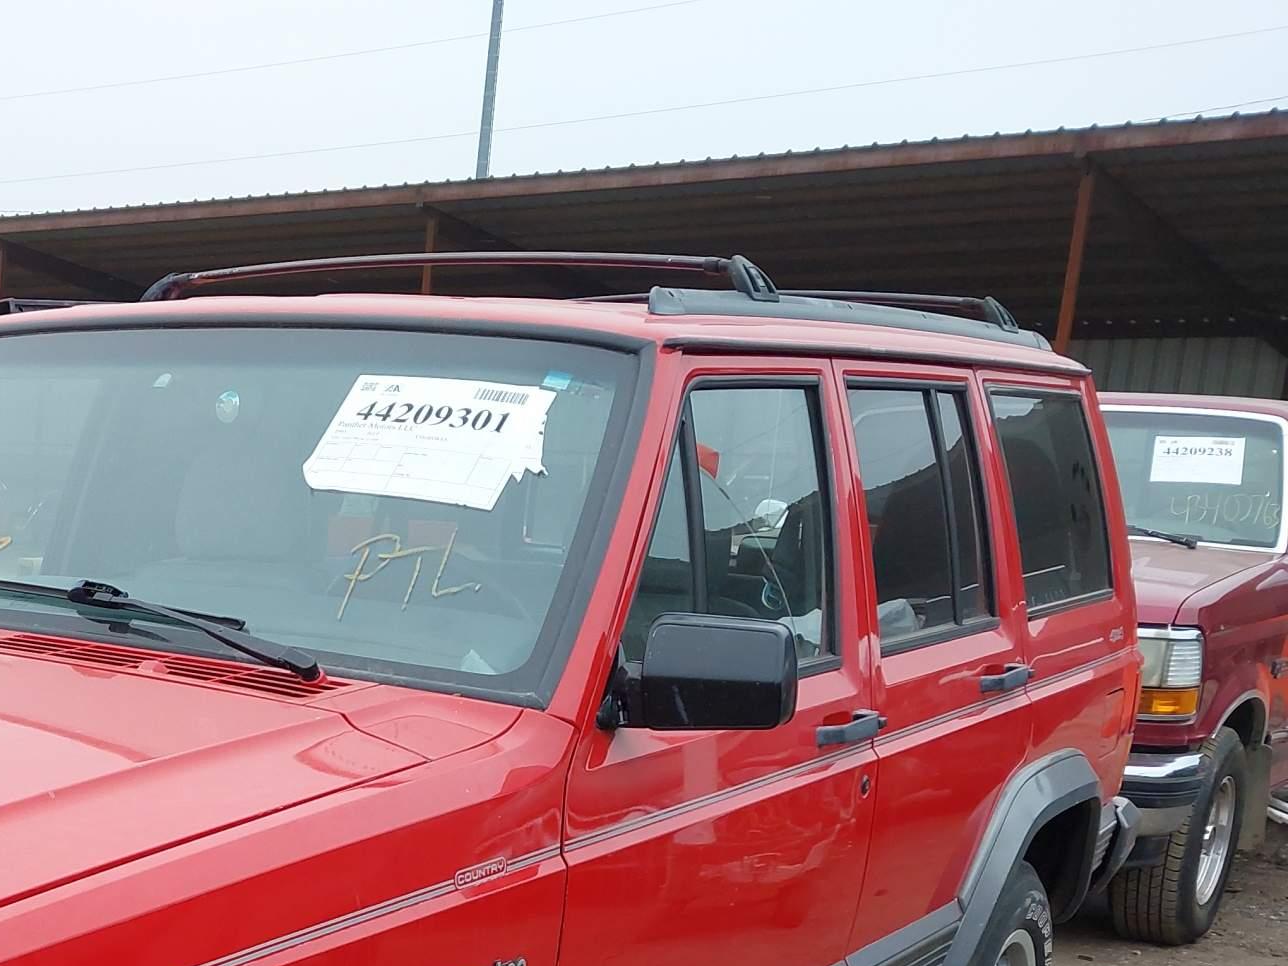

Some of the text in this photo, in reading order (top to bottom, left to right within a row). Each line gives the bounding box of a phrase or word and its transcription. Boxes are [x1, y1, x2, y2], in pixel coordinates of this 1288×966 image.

[356, 400, 510, 434] 44209301
[1163, 447, 1233, 457] 44209238
[458, 860, 505, 884] COUNTRY
